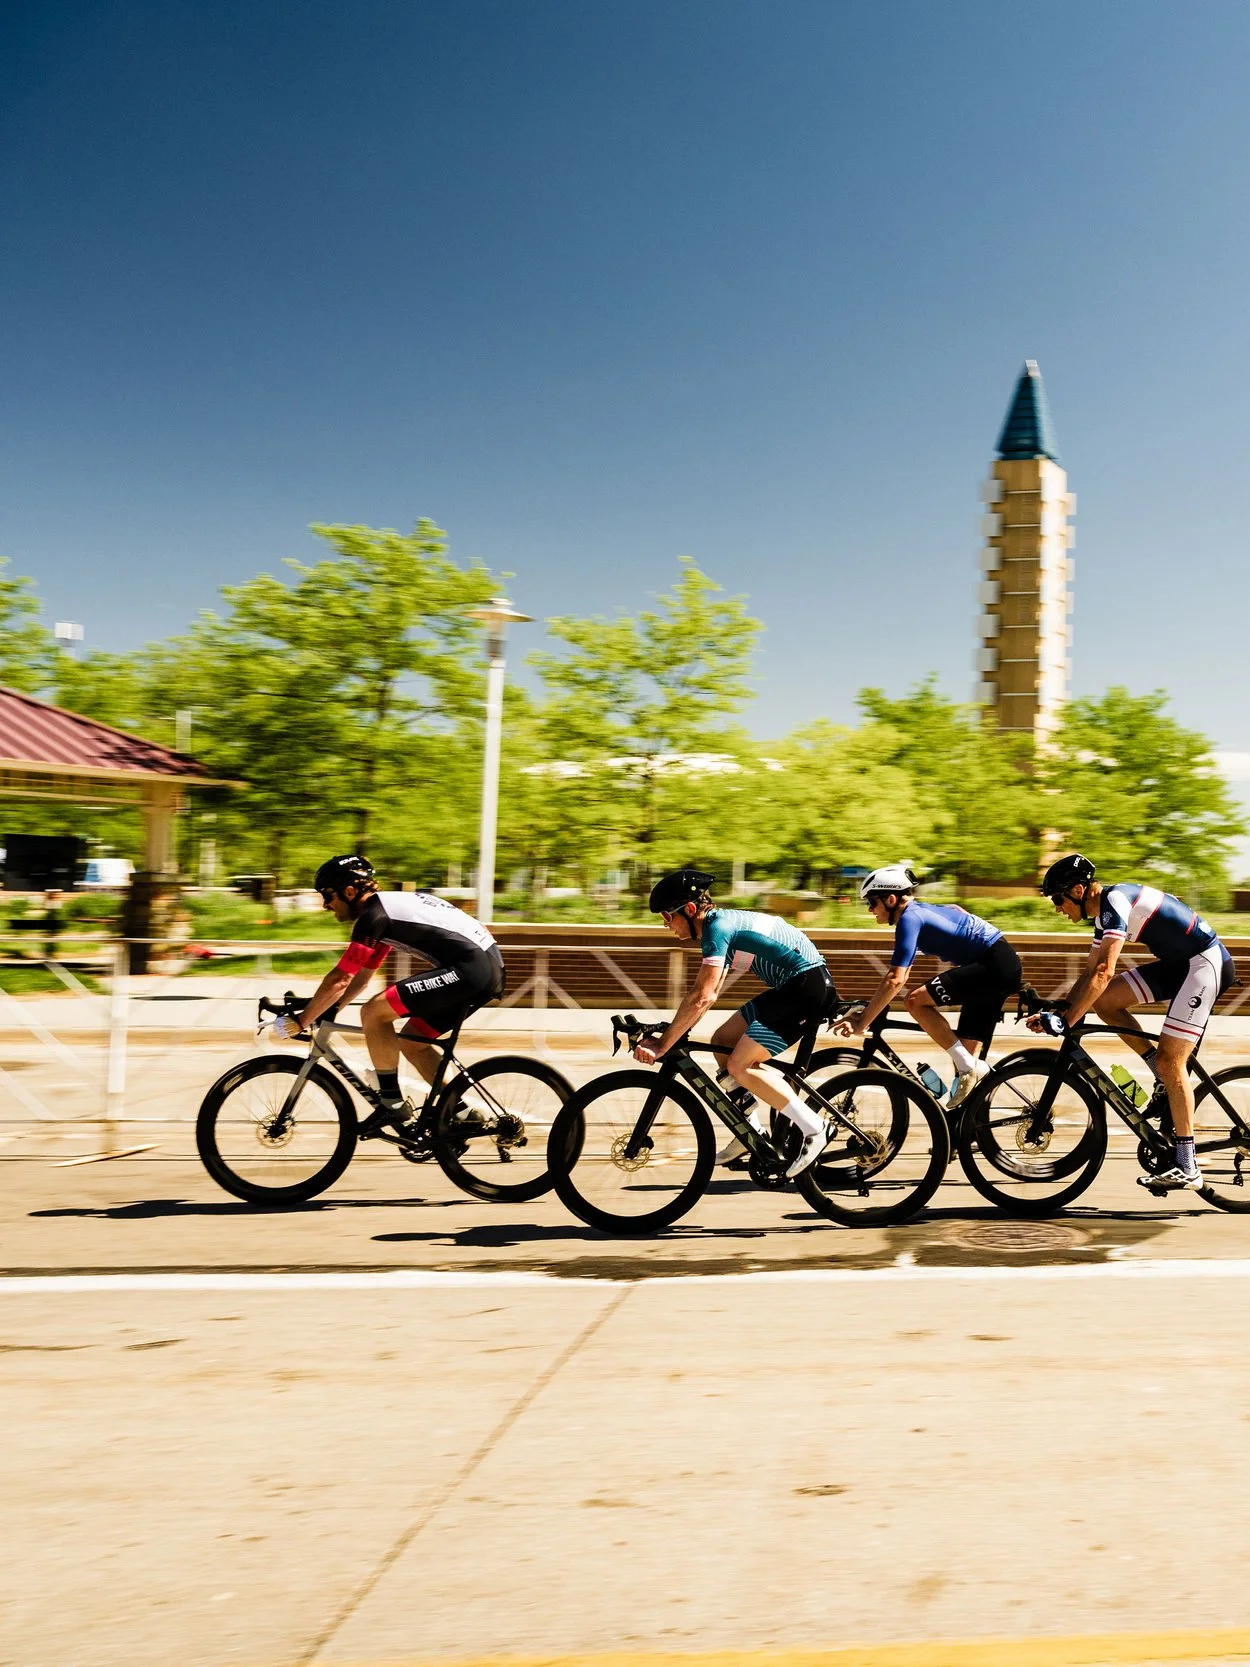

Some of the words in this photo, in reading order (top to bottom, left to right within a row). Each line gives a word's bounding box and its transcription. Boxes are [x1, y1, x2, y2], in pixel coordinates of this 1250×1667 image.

[405, 980, 425, 994] THE
[423, 975, 444, 990] BIKE
[930, 976, 950, 1003] VCC
